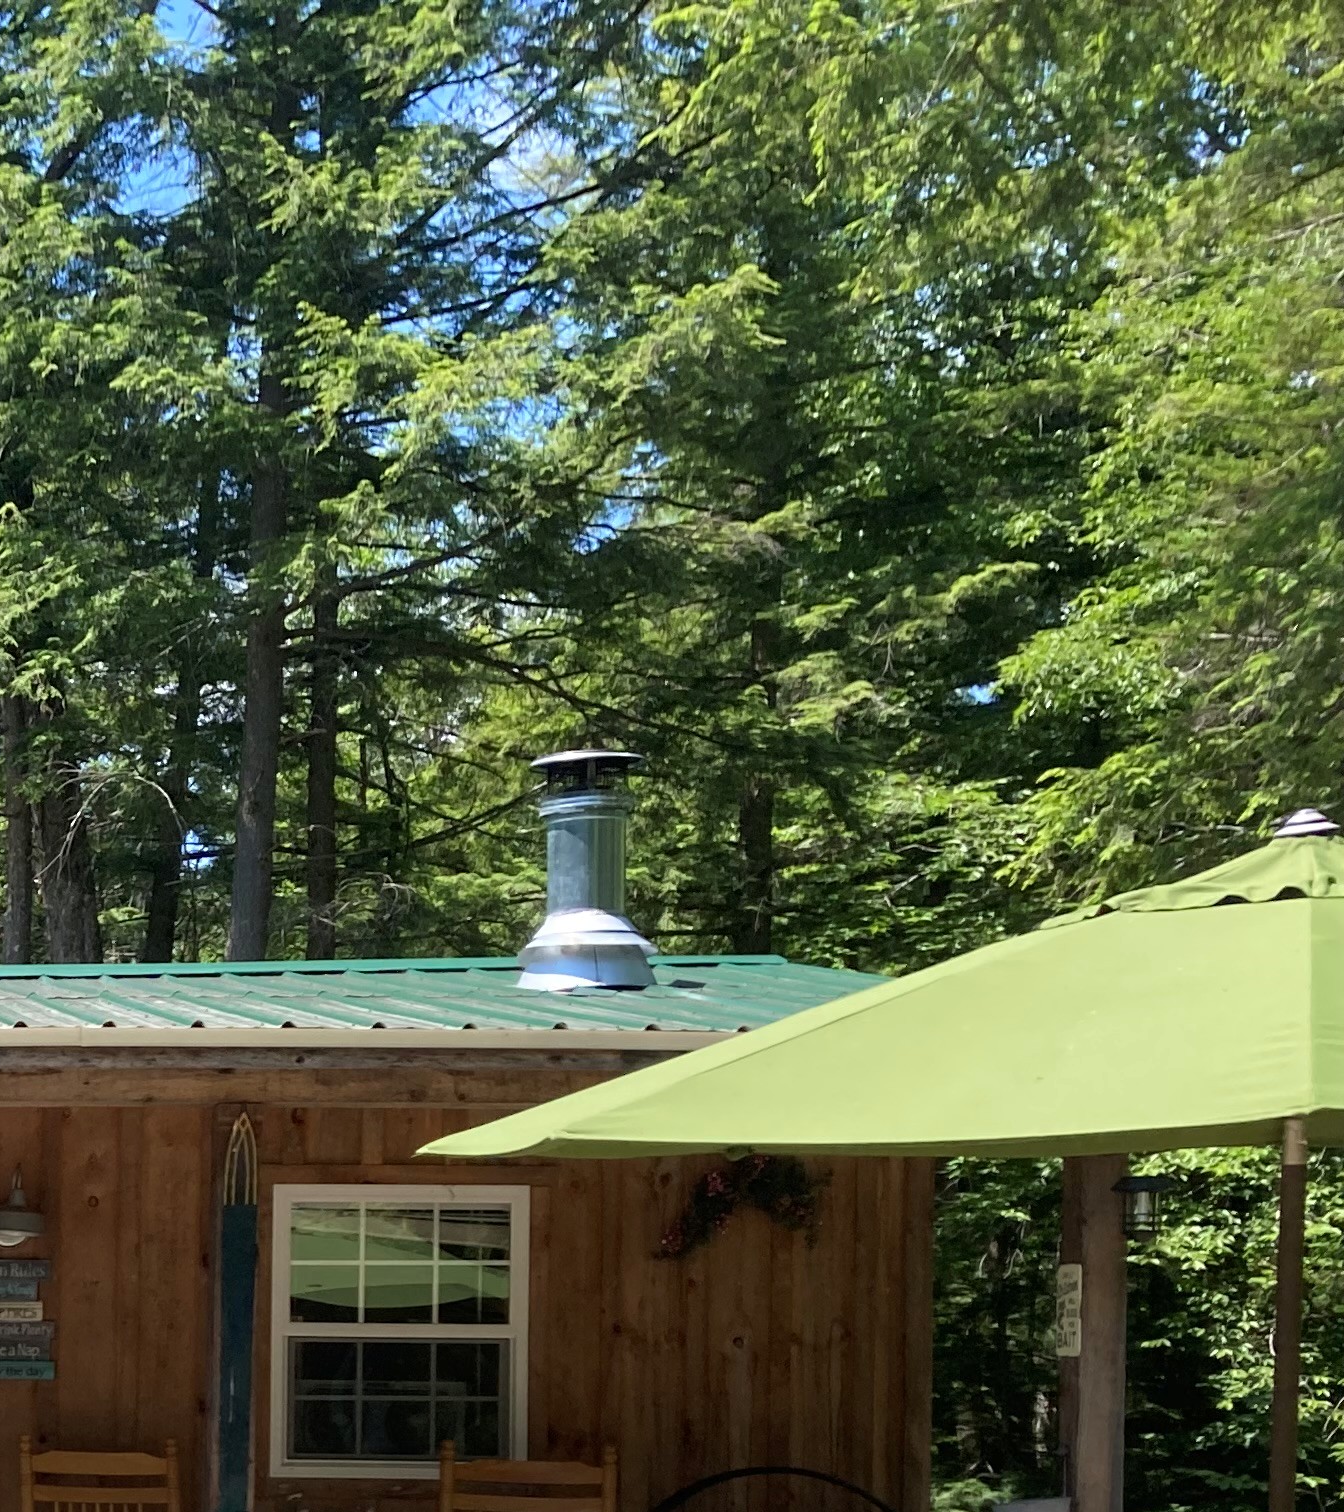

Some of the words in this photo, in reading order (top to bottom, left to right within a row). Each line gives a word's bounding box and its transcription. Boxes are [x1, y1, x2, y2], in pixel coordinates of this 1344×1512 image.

[9, 1262, 46, 1277] Rules
[7, 1346, 16, 1356] a
[17, 1343, 40, 1360] Nap
[5, 1366, 23, 1376] the
[25, 1366, 47, 1378] day
